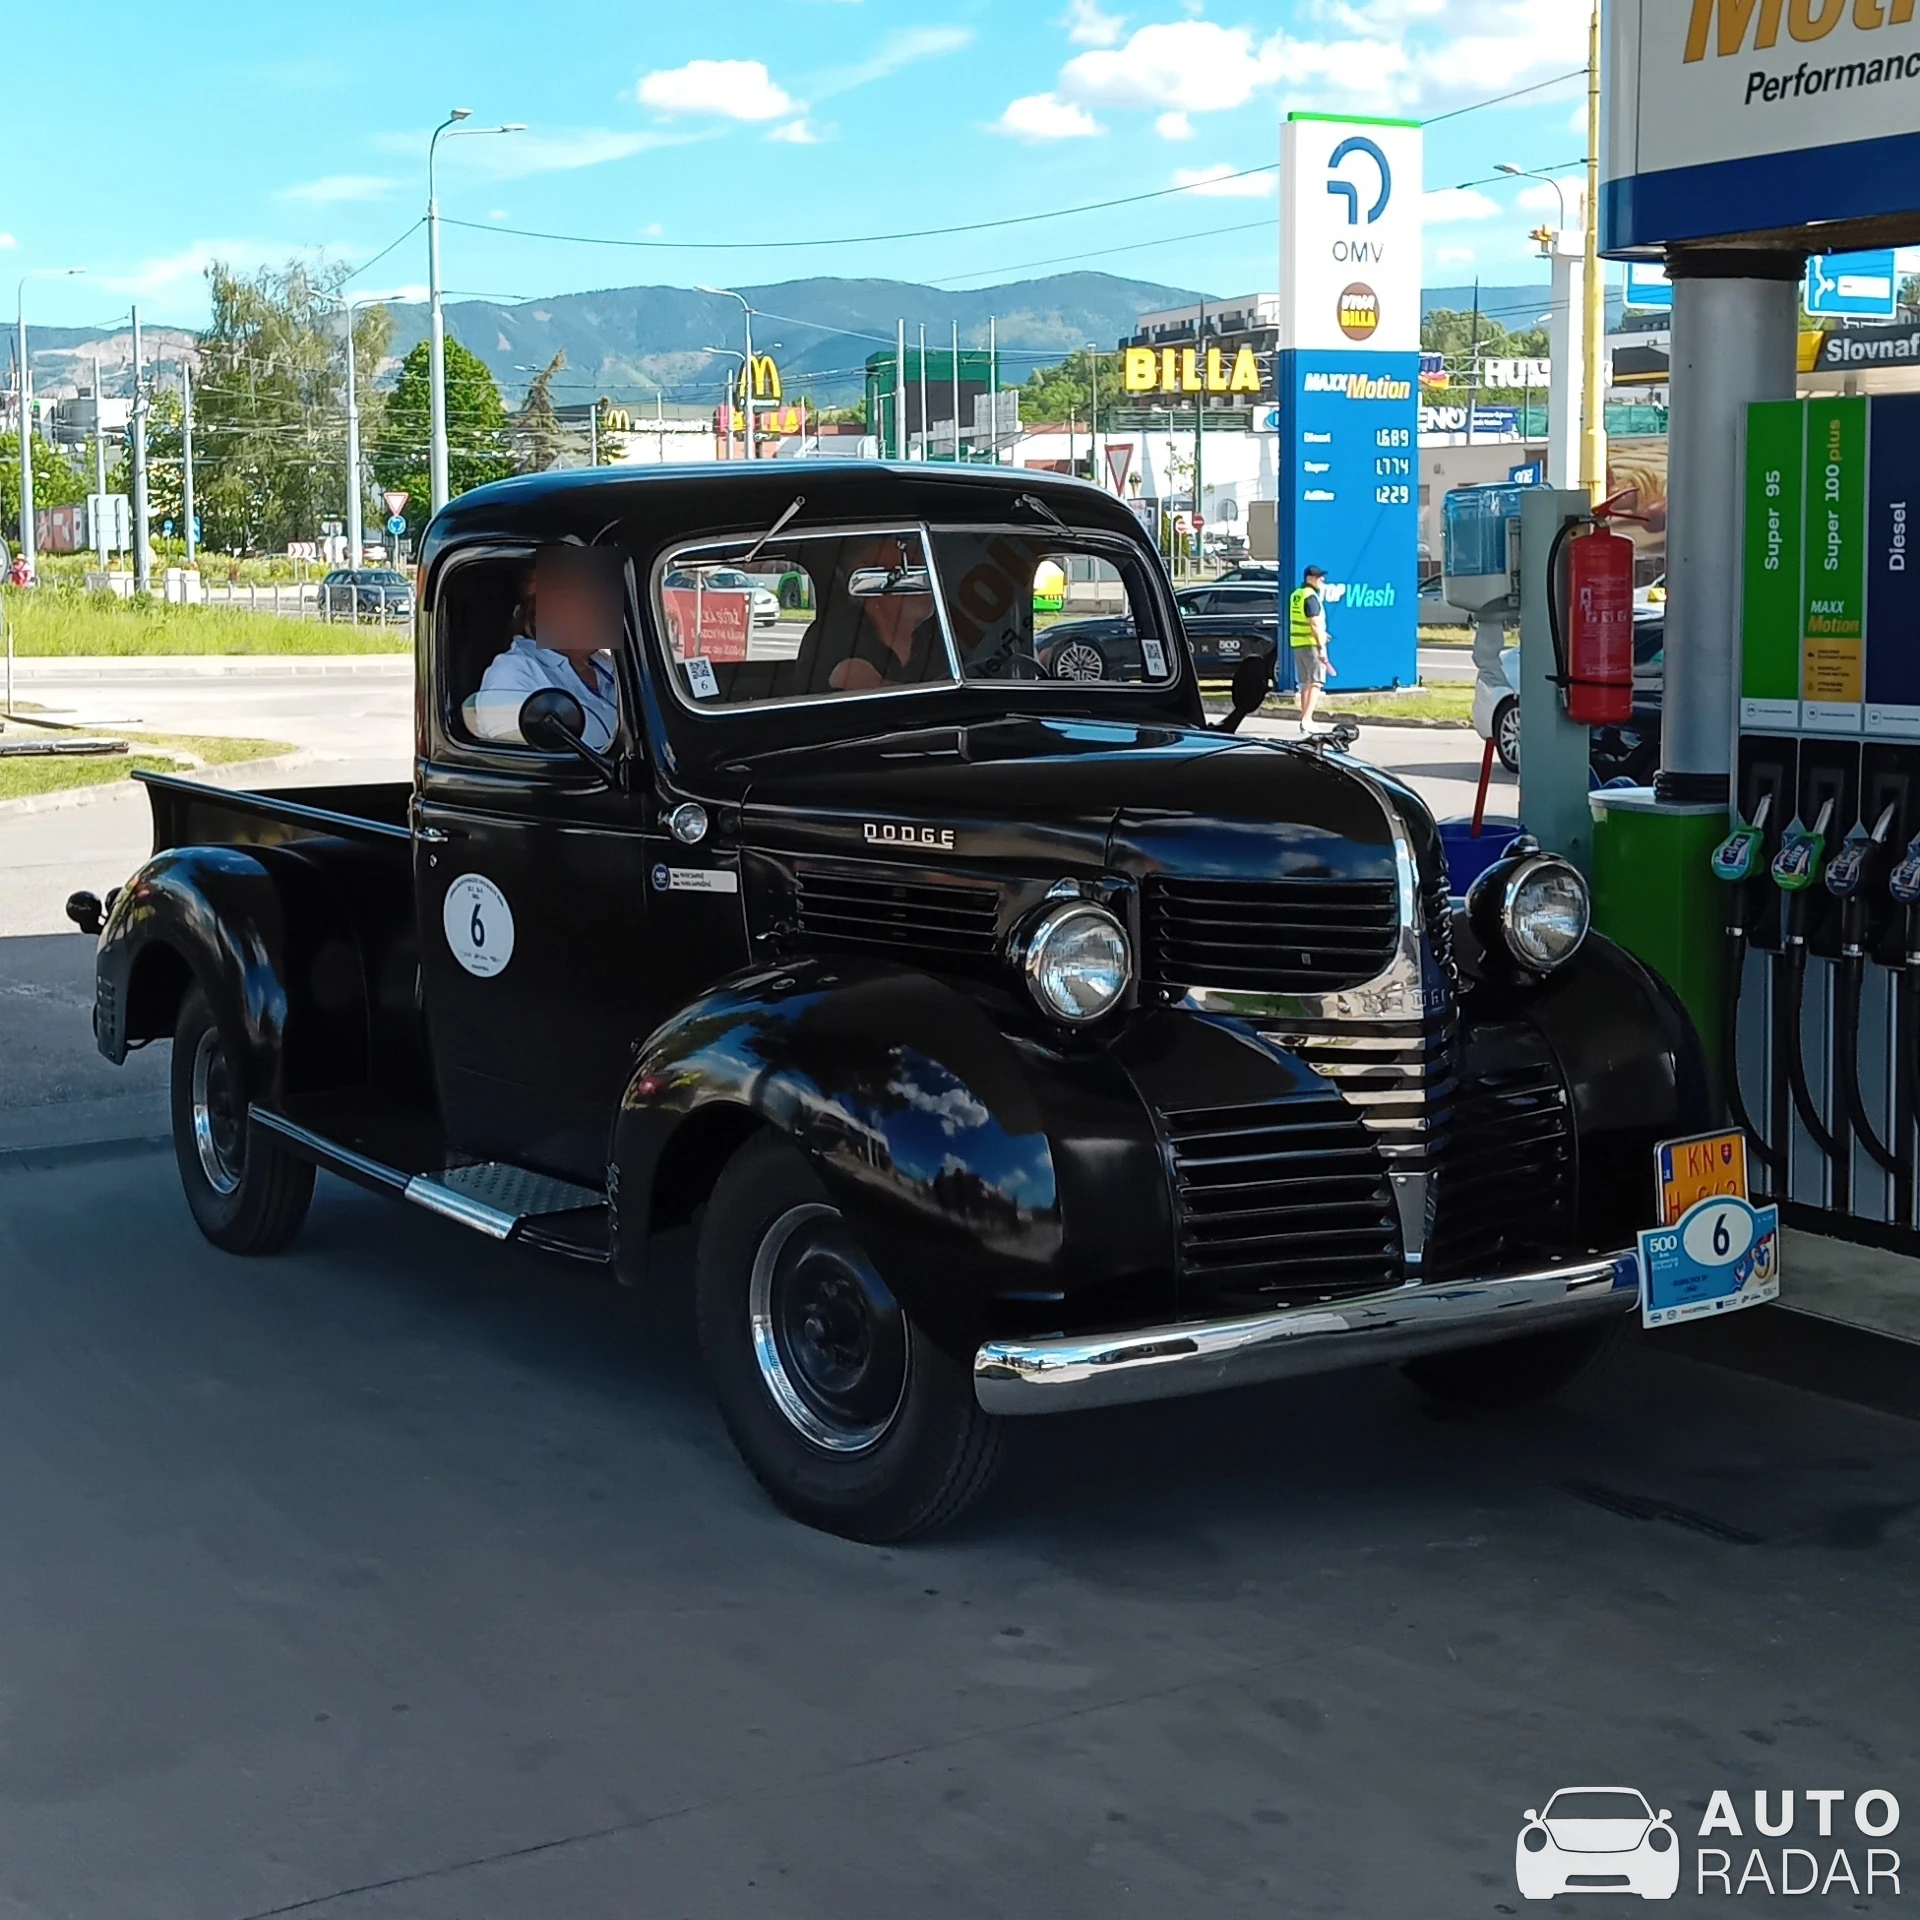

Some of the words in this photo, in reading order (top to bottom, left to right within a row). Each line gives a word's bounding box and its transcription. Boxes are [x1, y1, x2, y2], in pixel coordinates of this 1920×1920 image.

[1332, 240, 1384, 263] OMV
[1341, 310, 1377, 327] BILLA
[1126, 347, 1261, 392] BILLA
[1826, 418, 1843, 462] plus
[1765, 469, 1781, 498] 95
[1824, 464, 1840, 502] 100
[1764, 507, 1783, 571] Super
[1823, 509, 1843, 571] Super
[1888, 501, 1907, 571] Diesel
[1810, 600, 1844, 614] MAXX
[1807, 615, 1860, 633] Motion
[1152, 661, 1161, 672] 6
[701, 680, 710, 691] 6
[863, 823, 955, 848] DODGE
[470, 903, 486, 948] 6
[1687, 1142, 1715, 1177] KN
[1666, 1191, 1681, 1224] H
[1649, 1235, 1678, 1254] 500
[1712, 1212, 1731, 1257] 6
